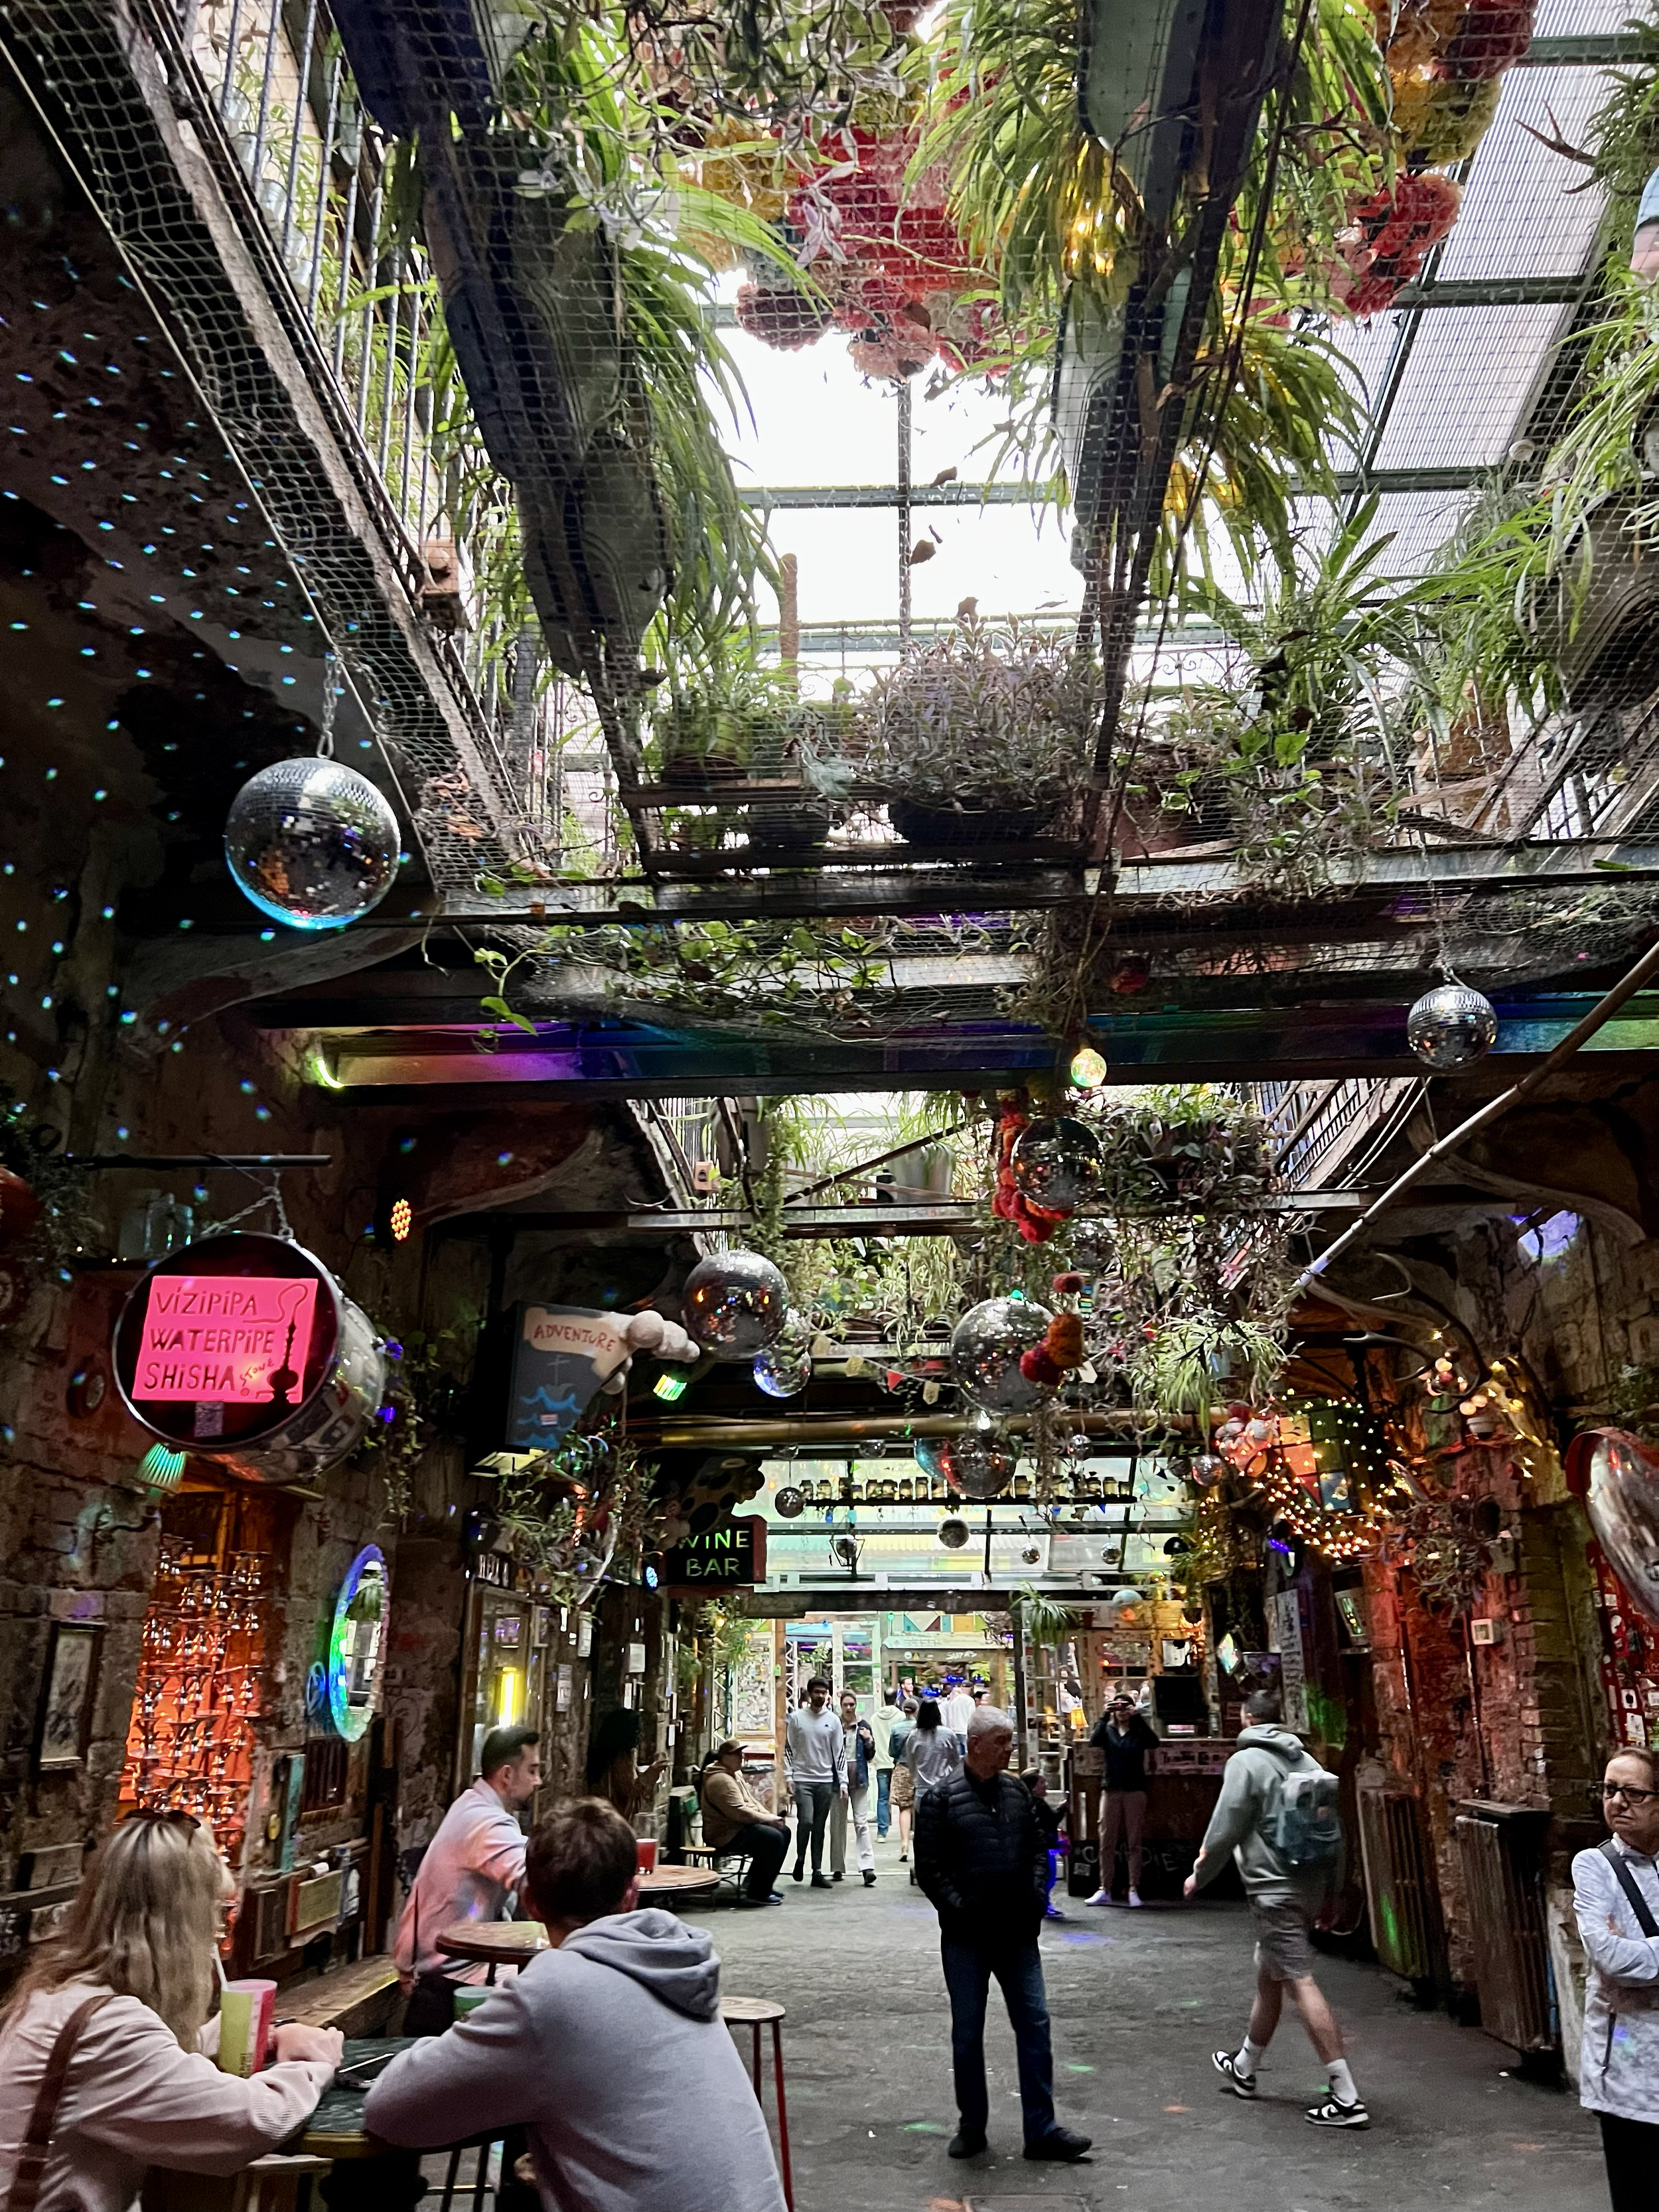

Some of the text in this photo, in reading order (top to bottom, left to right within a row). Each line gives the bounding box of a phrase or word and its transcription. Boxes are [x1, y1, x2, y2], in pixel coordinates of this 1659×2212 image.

[534, 1325, 616, 1352] ADVENTURE
[678, 1529, 750, 1550] WINE
[686, 1558, 741, 1576] BAR
